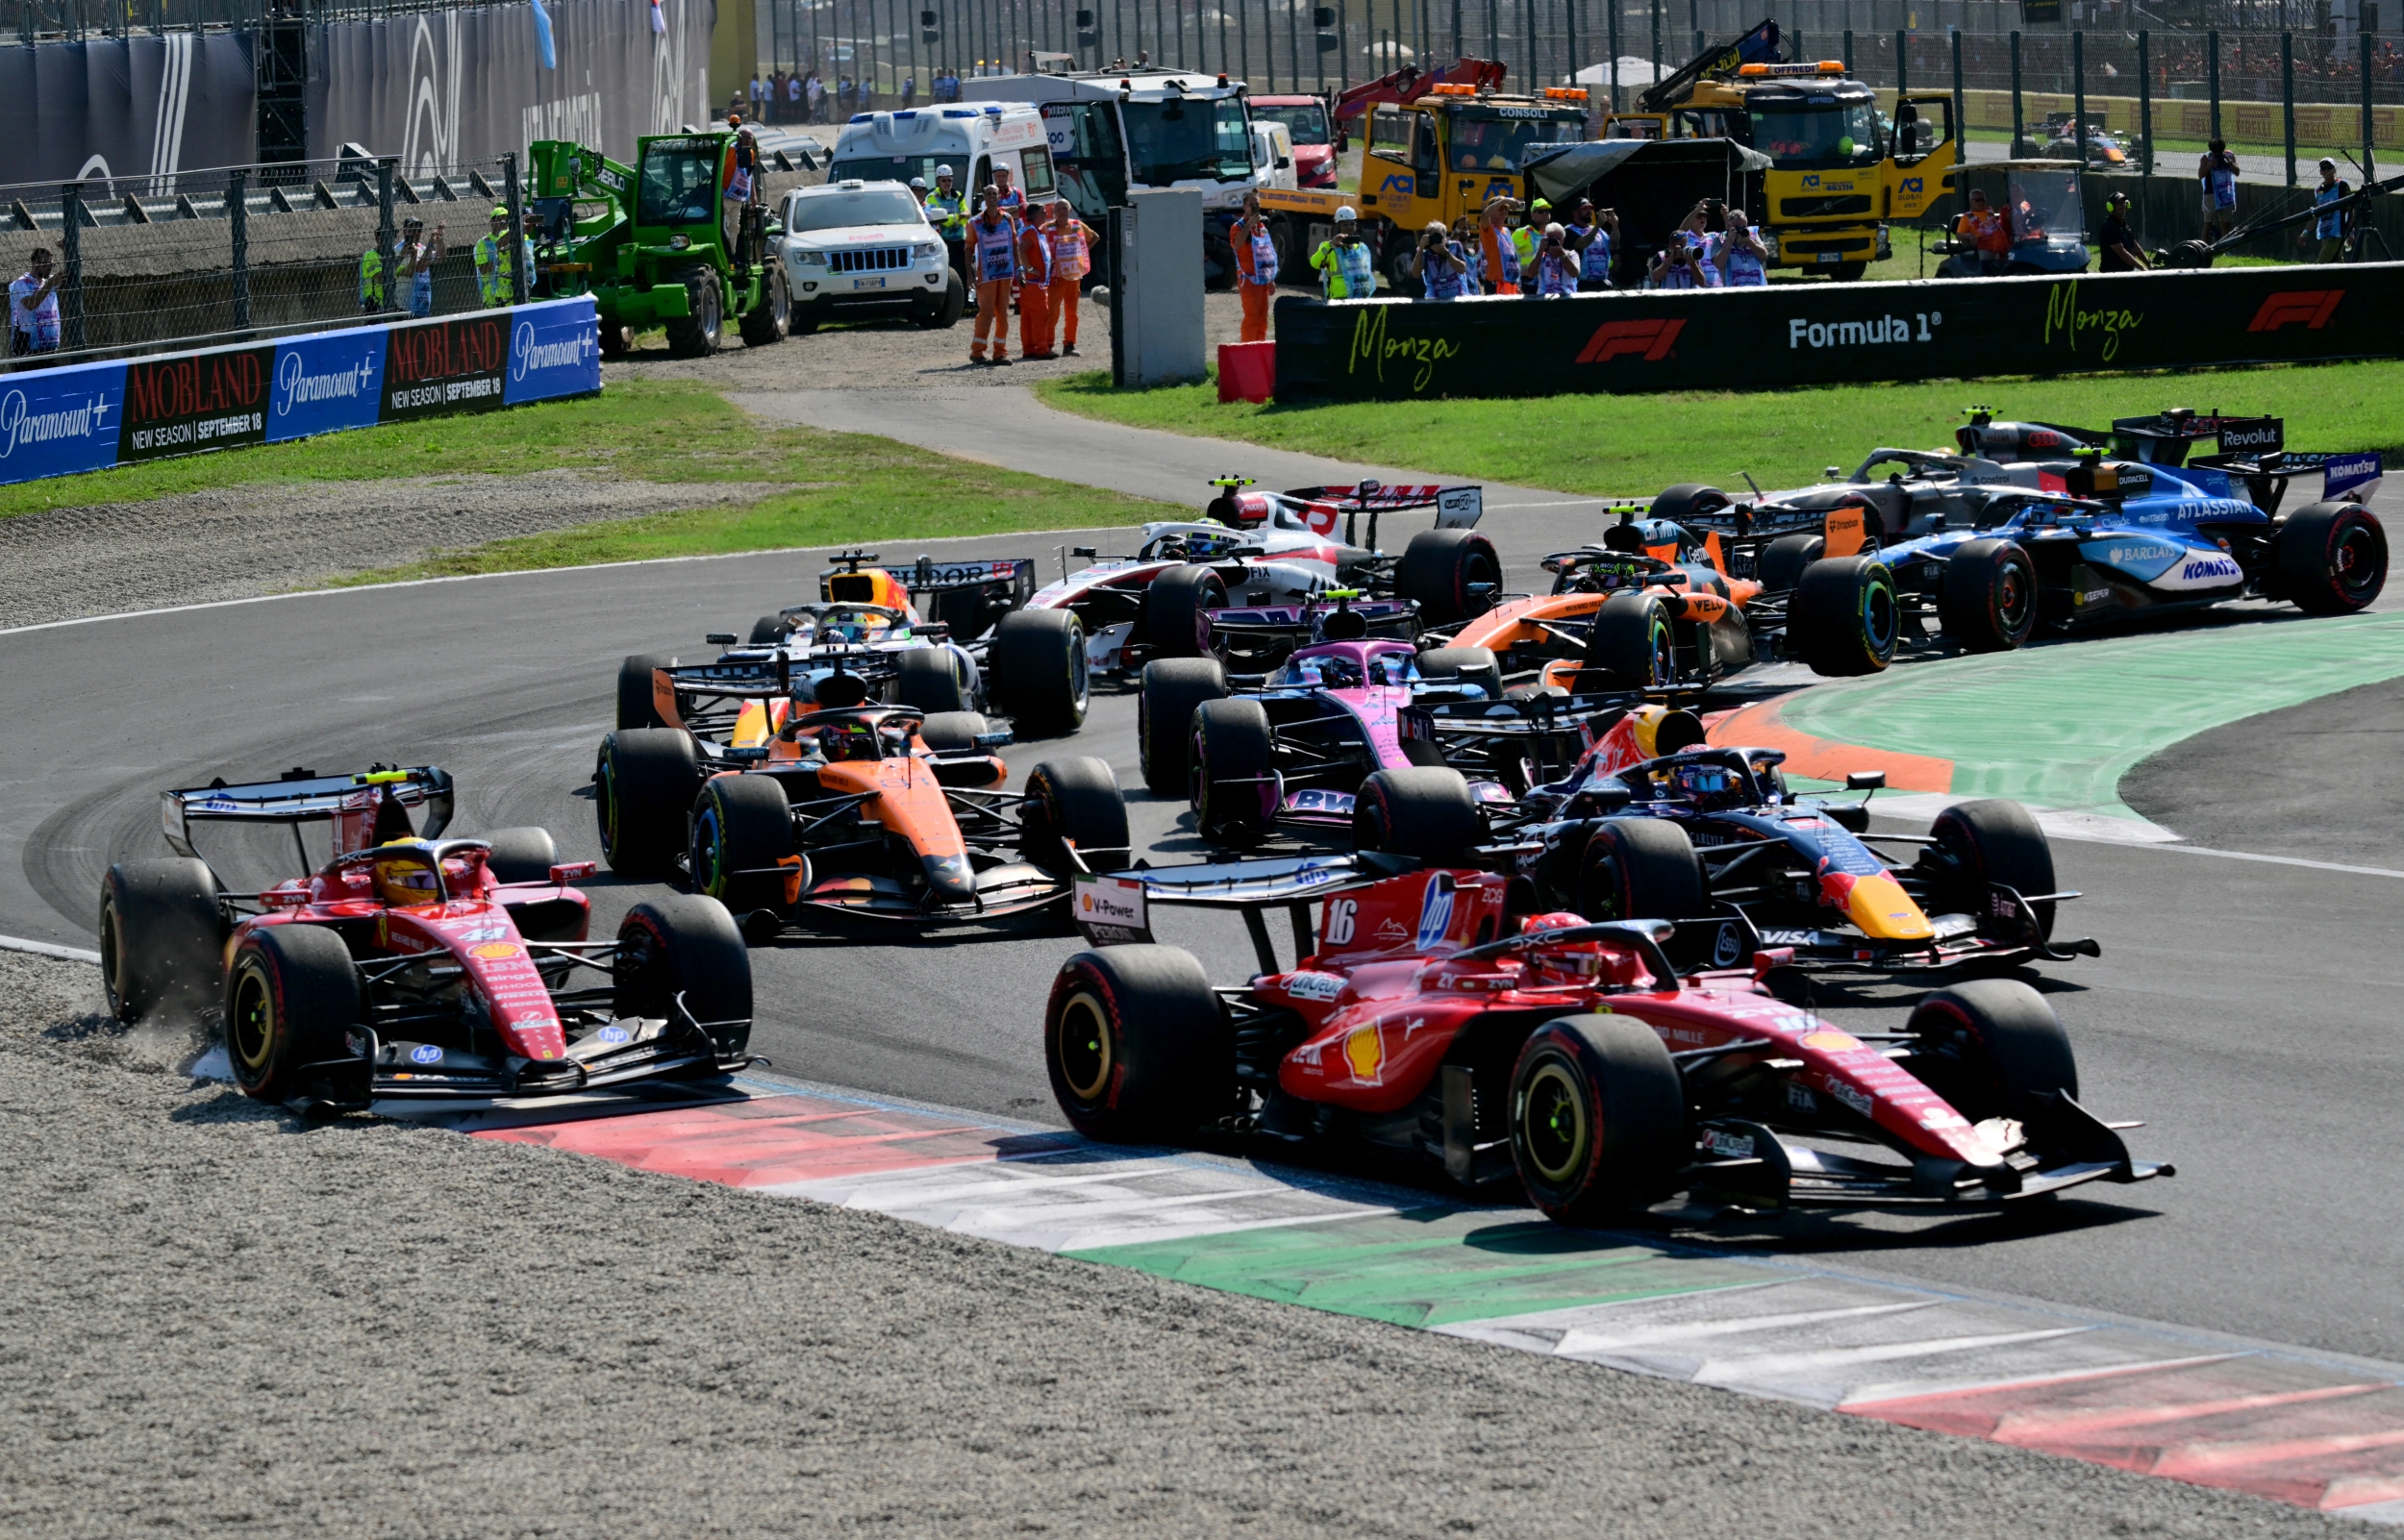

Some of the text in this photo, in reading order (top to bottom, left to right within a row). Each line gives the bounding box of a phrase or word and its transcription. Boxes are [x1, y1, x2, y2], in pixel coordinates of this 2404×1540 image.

[1773, 64, 1816, 74] OFFREDI
[1498, 107, 1548, 118] CONSOLI
[1378, 193, 1413, 203] GLOBAL
[2044, 276, 2144, 362] Monza
[1789, 313, 1910, 348] Formula
[391, 320, 501, 385] MOBLAND
[513, 321, 593, 382] Paramount+
[1348, 303, 1461, 392] Monza
[132, 352, 262, 423] MOBLAND
[277, 351, 374, 416] Paramount+
[391, 377, 501, 410] NEW SEASON SEPTEMBER 18
[0, 388, 108, 459] Paramount+
[132, 411, 263, 451] NEW SEASON SEPTEMBER 18
[2120, 437, 2133, 451] bp
[2223, 428, 2277, 447] Revolut
[2329, 458, 2377, 479] KOMATSU
[1980, 474, 2010, 484] Castrol
[2118, 473, 2150, 485] DURACELL
[2177, 499, 2253, 520] ATLASSIAN
[1836, 519, 1859, 531] Dropbox
[2101, 514, 2132, 528] Claude
[2124, 545, 2176, 561] BARCLAYS
[1251, 566, 1270, 578] FIX
[1924, 566, 1940, 577] FIA
[2182, 558, 2241, 581] KOMATSU
[2084, 588, 2110, 602] KEEPER
[1693, 598, 1723, 613] VELO
[1689, 832, 1725, 846] CARLYLE
[563, 868, 583, 880] ZYN
[282, 893, 307, 905] ZYN
[1092, 897, 1135, 919] V-Power
[1416, 872, 1455, 951] hp
[438, 917, 511, 931] ZYN
[1324, 898, 1358, 946] 16
[1935, 918, 1972, 939] VISA
[457, 926, 509, 942] 44
[1088, 922, 1137, 941] PERONI
[1760, 930, 1820, 945] VISA
[391, 931, 426, 952] RICHARD MILLE
[1719, 931, 1738, 956] Esso
[477, 960, 533, 975] IBM
[1488, 979, 1515, 989] ZYN
[1772, 1014, 1819, 1031] 16
[604, 1027, 626, 1044] hp
[1673, 1029, 1705, 1045] MILLE
[416, 1045, 439, 1064] hp
